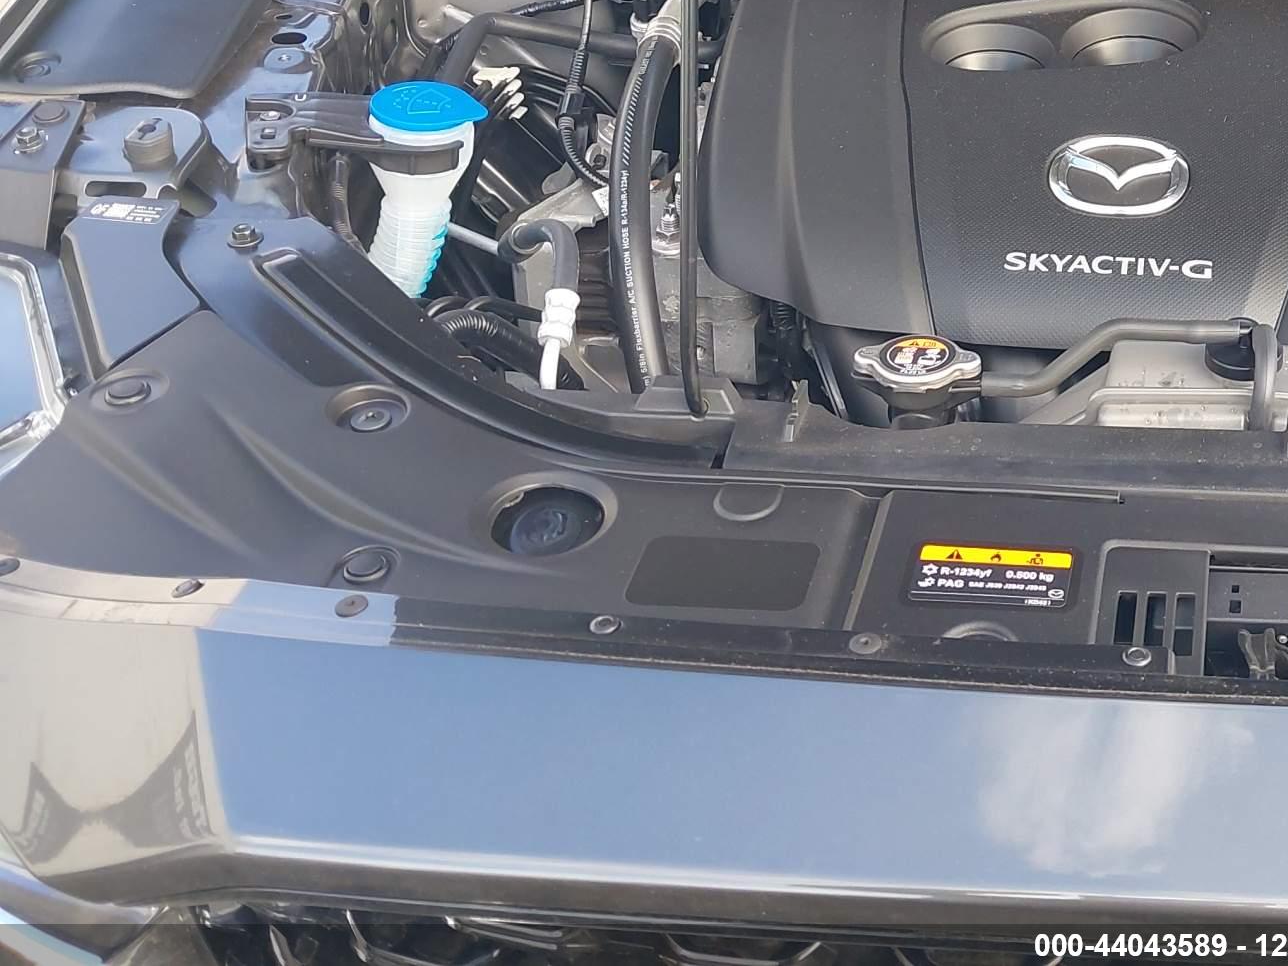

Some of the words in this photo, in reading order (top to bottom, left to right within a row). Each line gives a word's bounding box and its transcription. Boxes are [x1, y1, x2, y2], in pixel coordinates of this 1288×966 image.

[621, 227, 630, 249] HOSE
[623, 251, 634, 287] SUCTION
[1003, 251, 1213, 279] SKYACTIV-G
[628, 289, 637, 304] A/C
[631, 306, 644, 351] Flexbarrier
[937, 579, 965, 588] PAG
[940, 566, 992, 578] R-1234yf
[1038, 571, 1054, 583] kg
